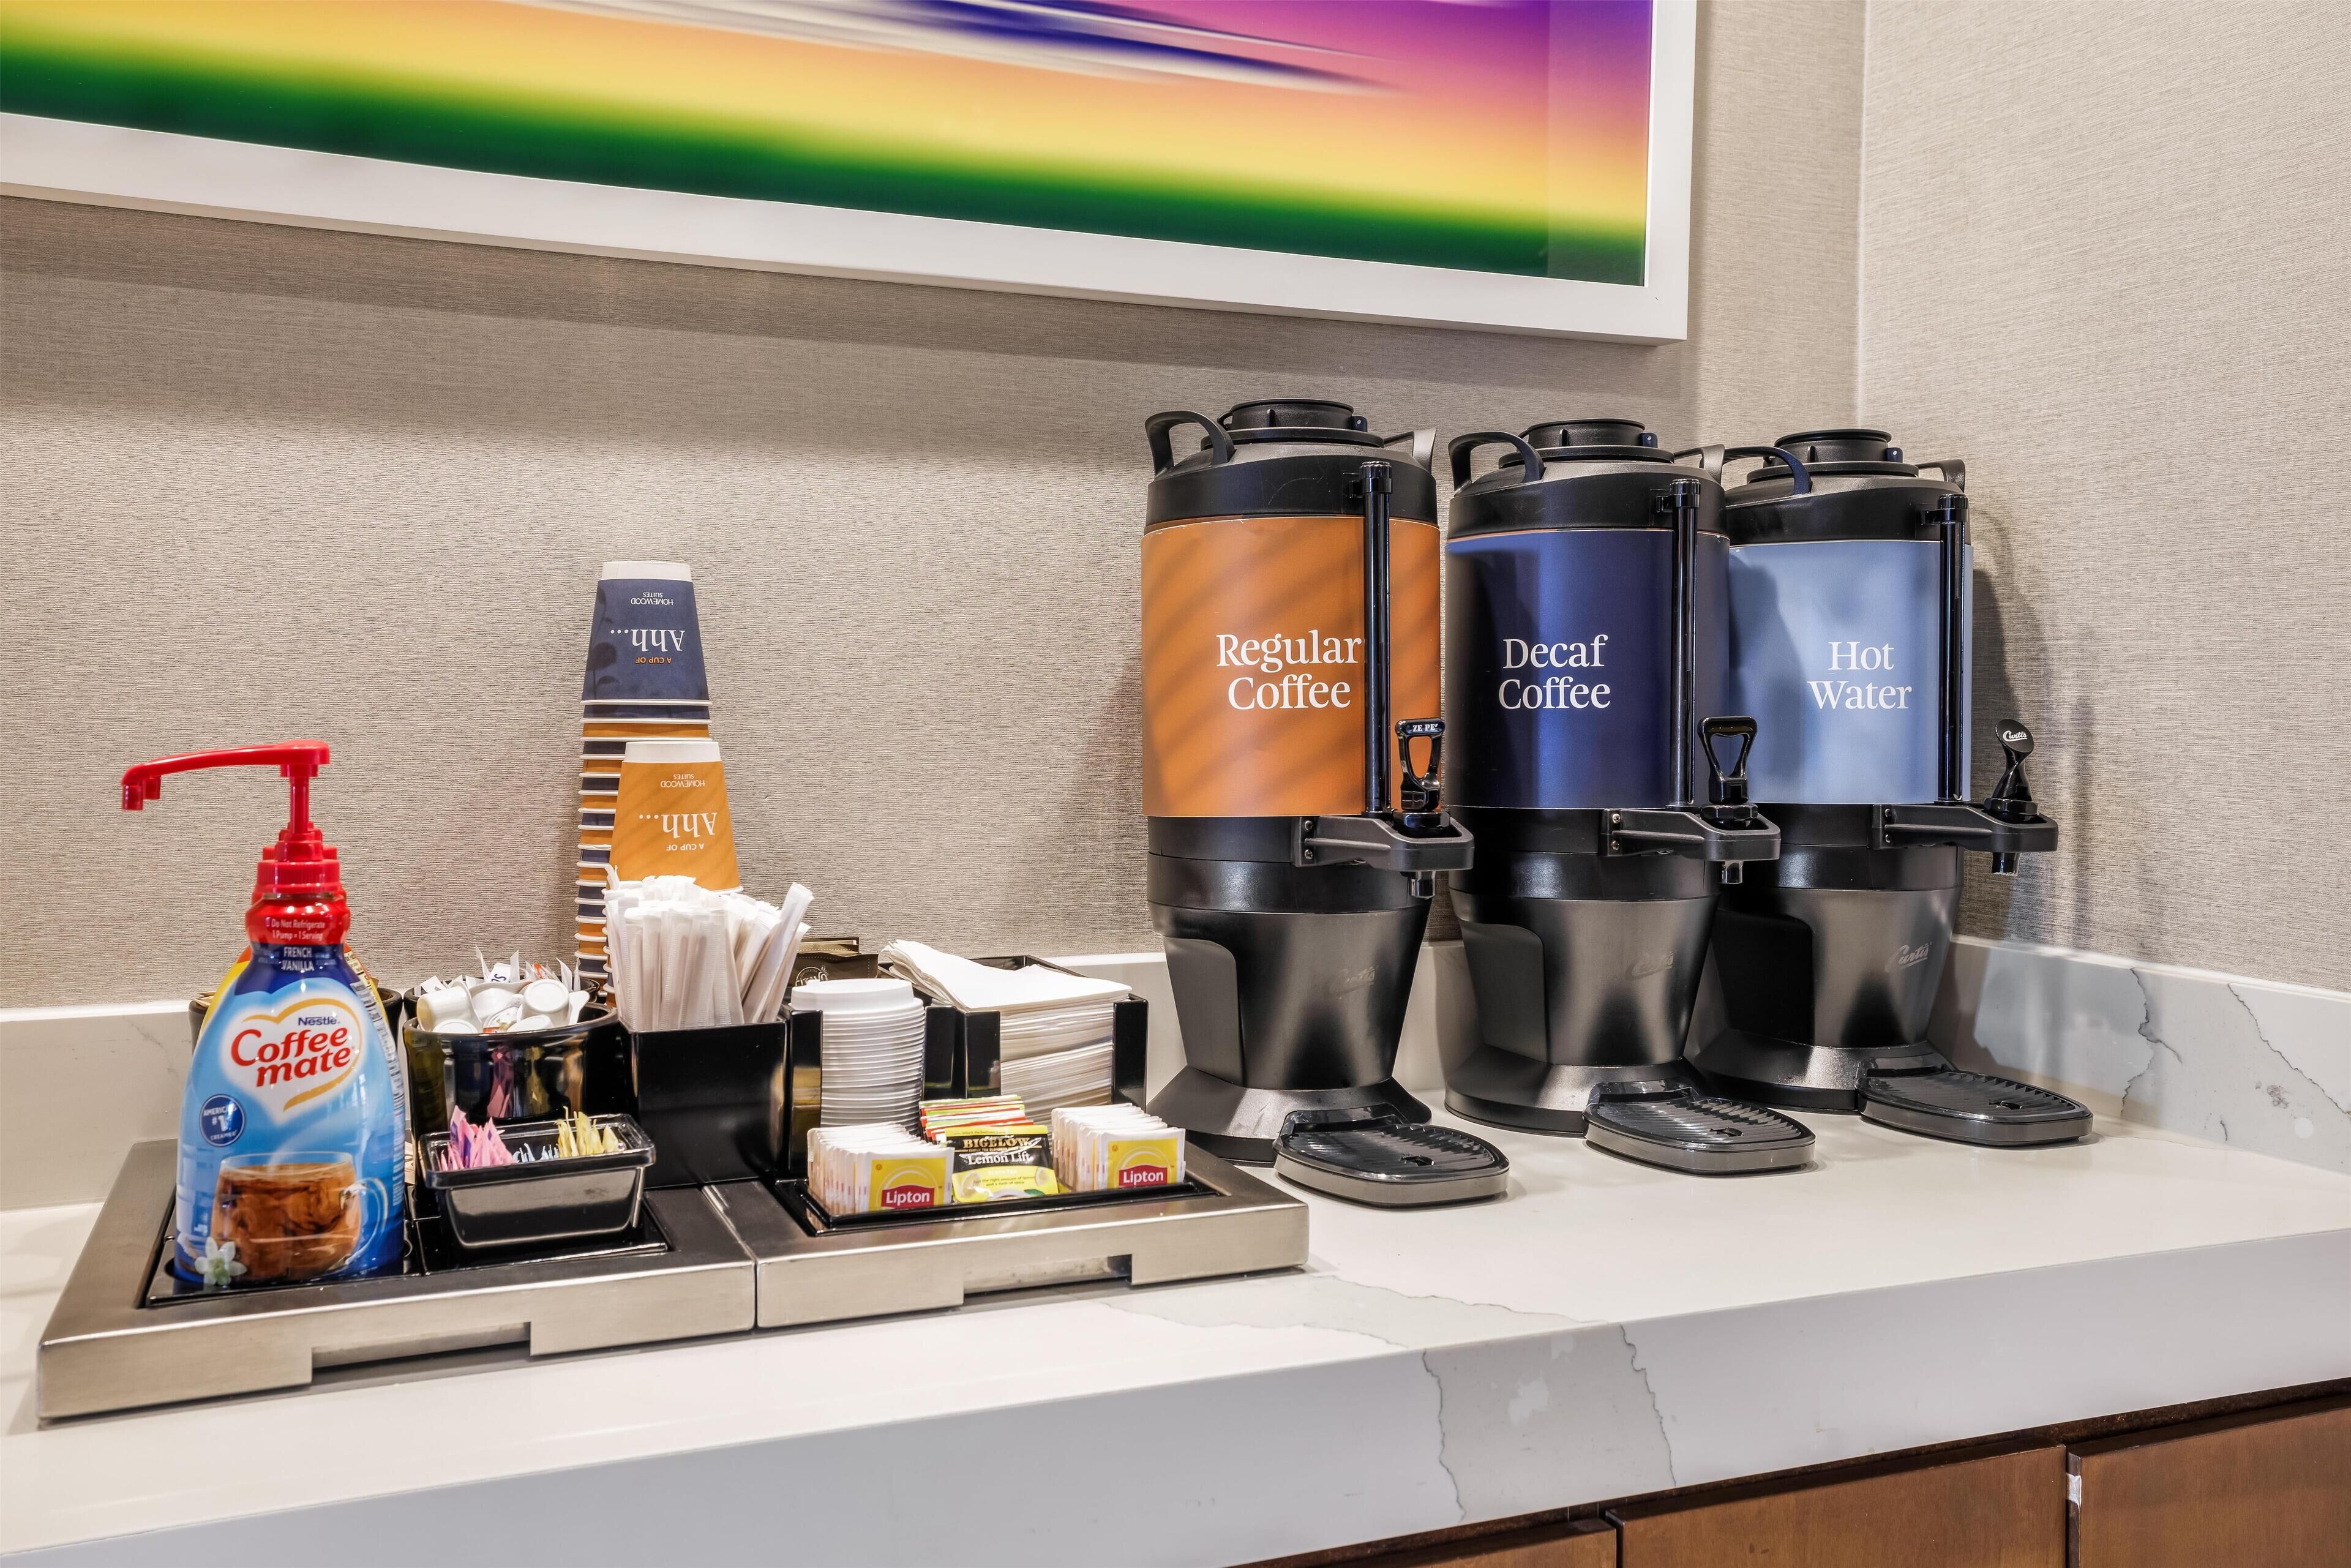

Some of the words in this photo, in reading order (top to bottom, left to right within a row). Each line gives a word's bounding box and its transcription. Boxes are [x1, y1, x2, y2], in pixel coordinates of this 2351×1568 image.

[610, 629, 686, 652] Ahh...
[1216, 629, 1362, 673] Regular
[1502, 634, 1609, 669] Decaf
[1827, 641, 1895, 670] Hot
[1228, 673, 1351, 710] Coffee
[1498, 676, 1611, 710] Coffee
[1807, 680, 1913, 710] Water
[2003, 730, 2028, 742] Curtis
[661, 779, 705, 788] HOMEWOOD
[639, 812, 718, 838] Ahh...
[271, 919, 280, 928] Do
[293, 920, 326, 930] Refrigerate
[276, 930, 293, 940] Pump
[302, 931, 323, 941] Serving
[283, 947, 312, 958] FRENCH
[282, 959, 315, 972] VANILLA
[230, 1027, 348, 1067] Coffee
[255, 1048, 351, 1087] mate
[962, 1138, 1030, 1148] BIGELOW
[968, 1155, 1009, 1165] Lemon
[1011, 1151, 1031, 1163] Lift
[1123, 1170, 1164, 1186] Lipton
[886, 1191, 930, 1206] Lipton
